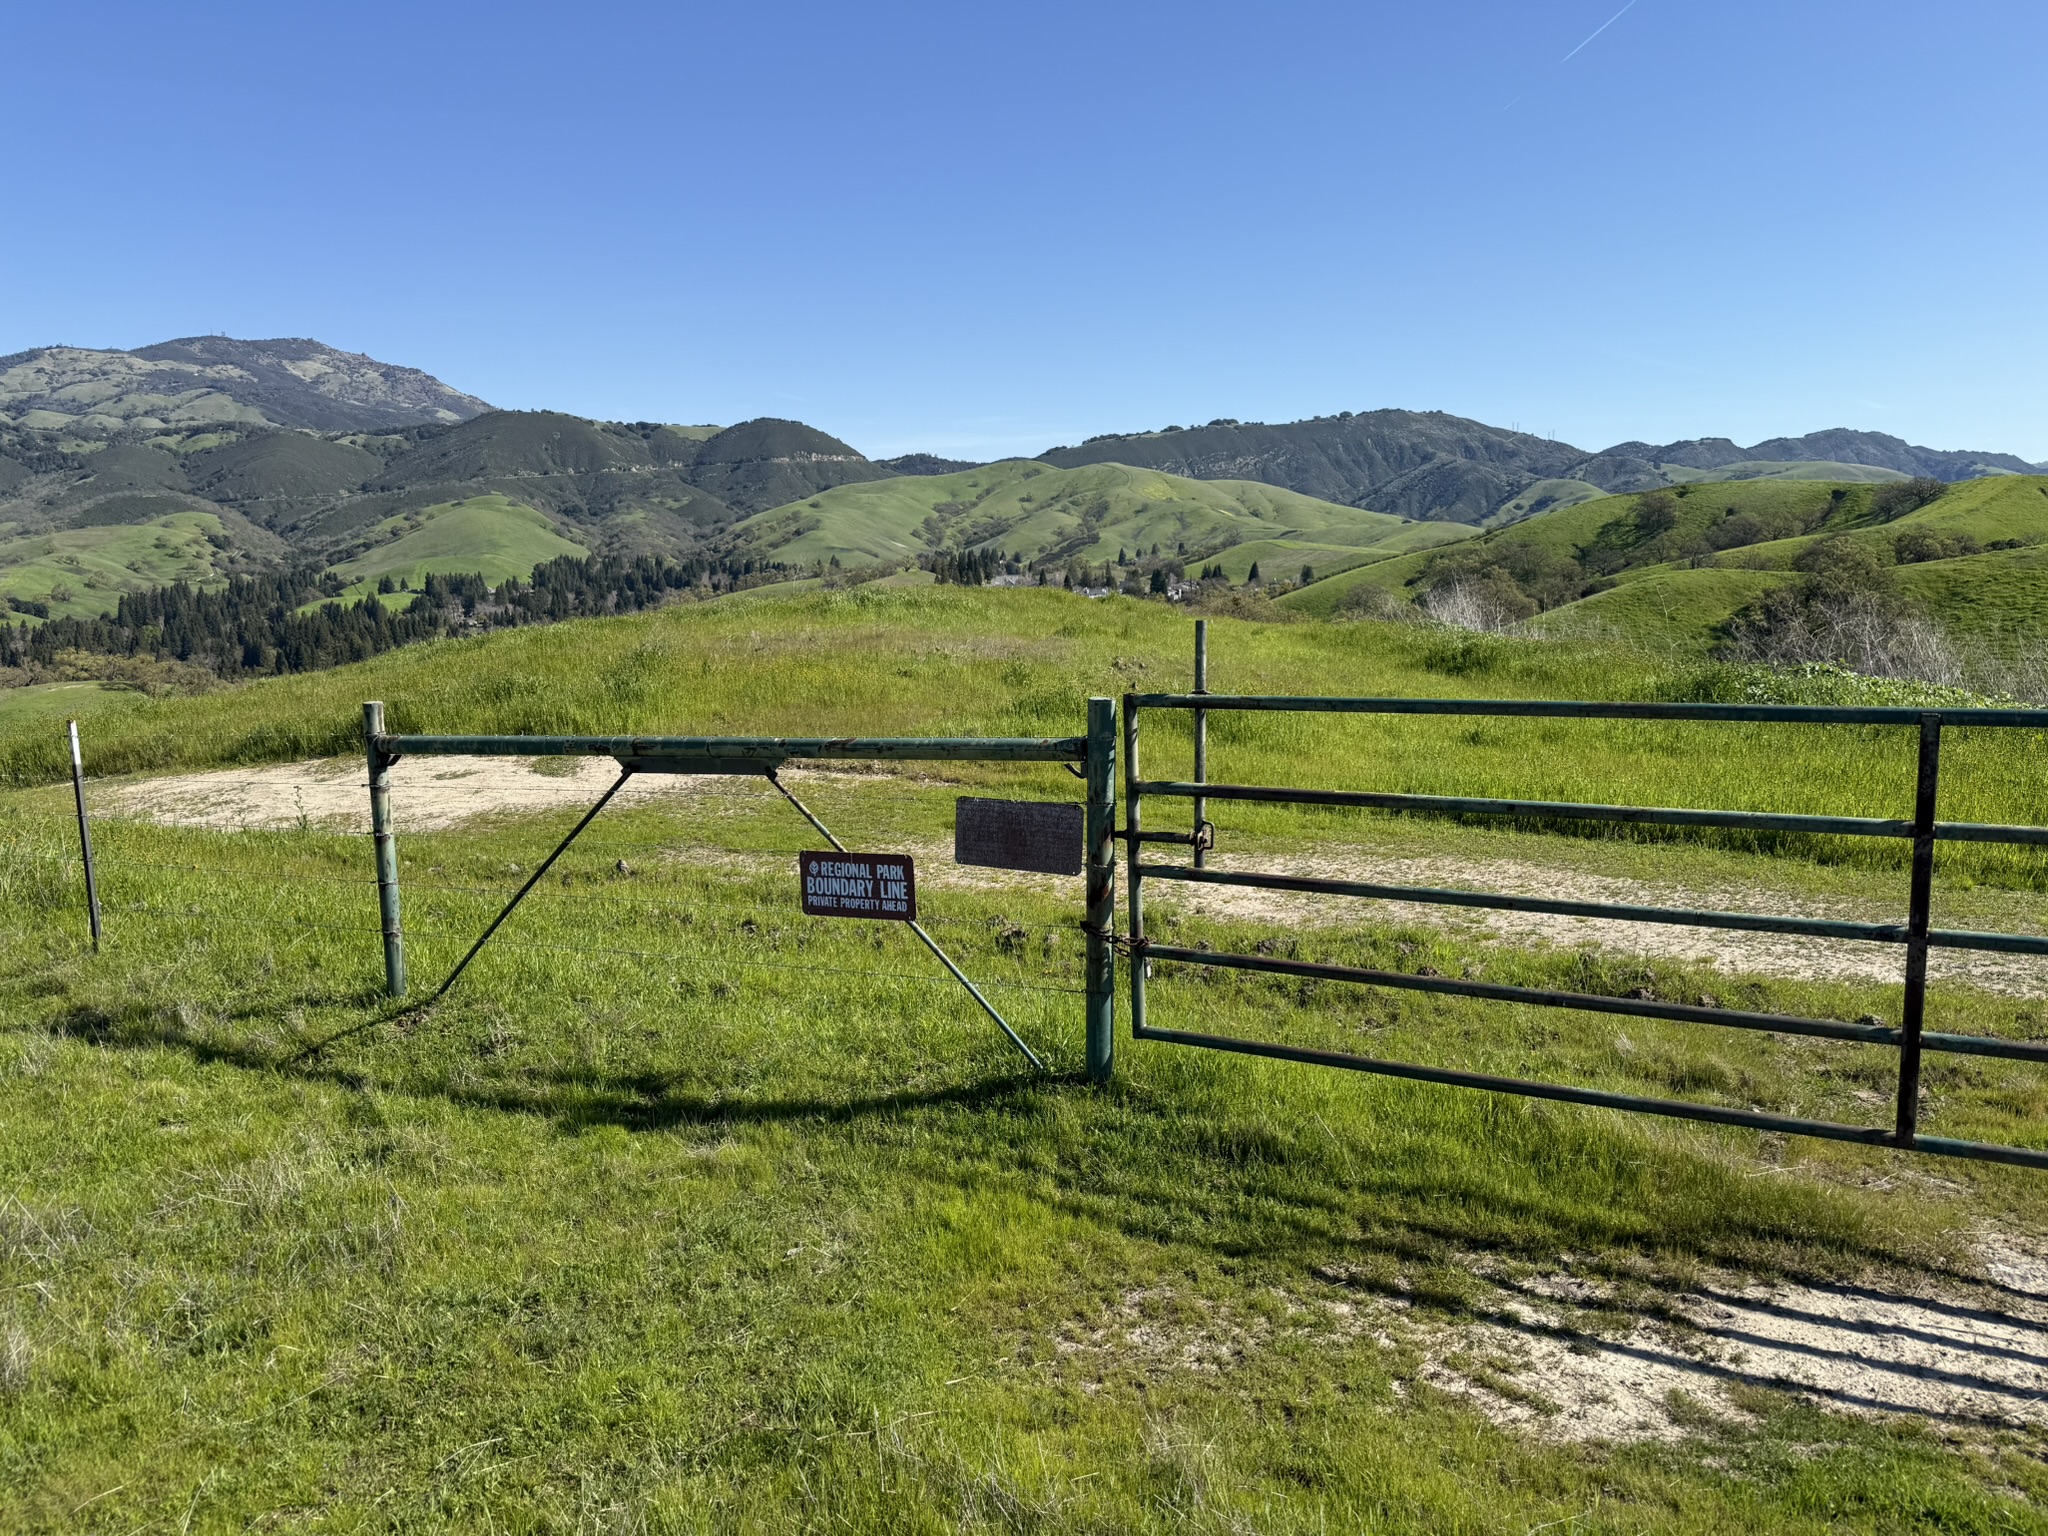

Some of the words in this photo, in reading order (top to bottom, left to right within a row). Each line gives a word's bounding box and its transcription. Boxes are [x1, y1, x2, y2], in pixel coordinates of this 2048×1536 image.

[821, 861, 872, 879] REGIONAL
[876, 864, 905, 880] PARK
[806, 876, 873, 898] BOUNDARY
[880, 880, 908, 900] LINE
[807, 895, 838, 908] PRIVATE
[840, 897, 880, 910] PROPERTY
[882, 900, 907, 912] AHEAD
